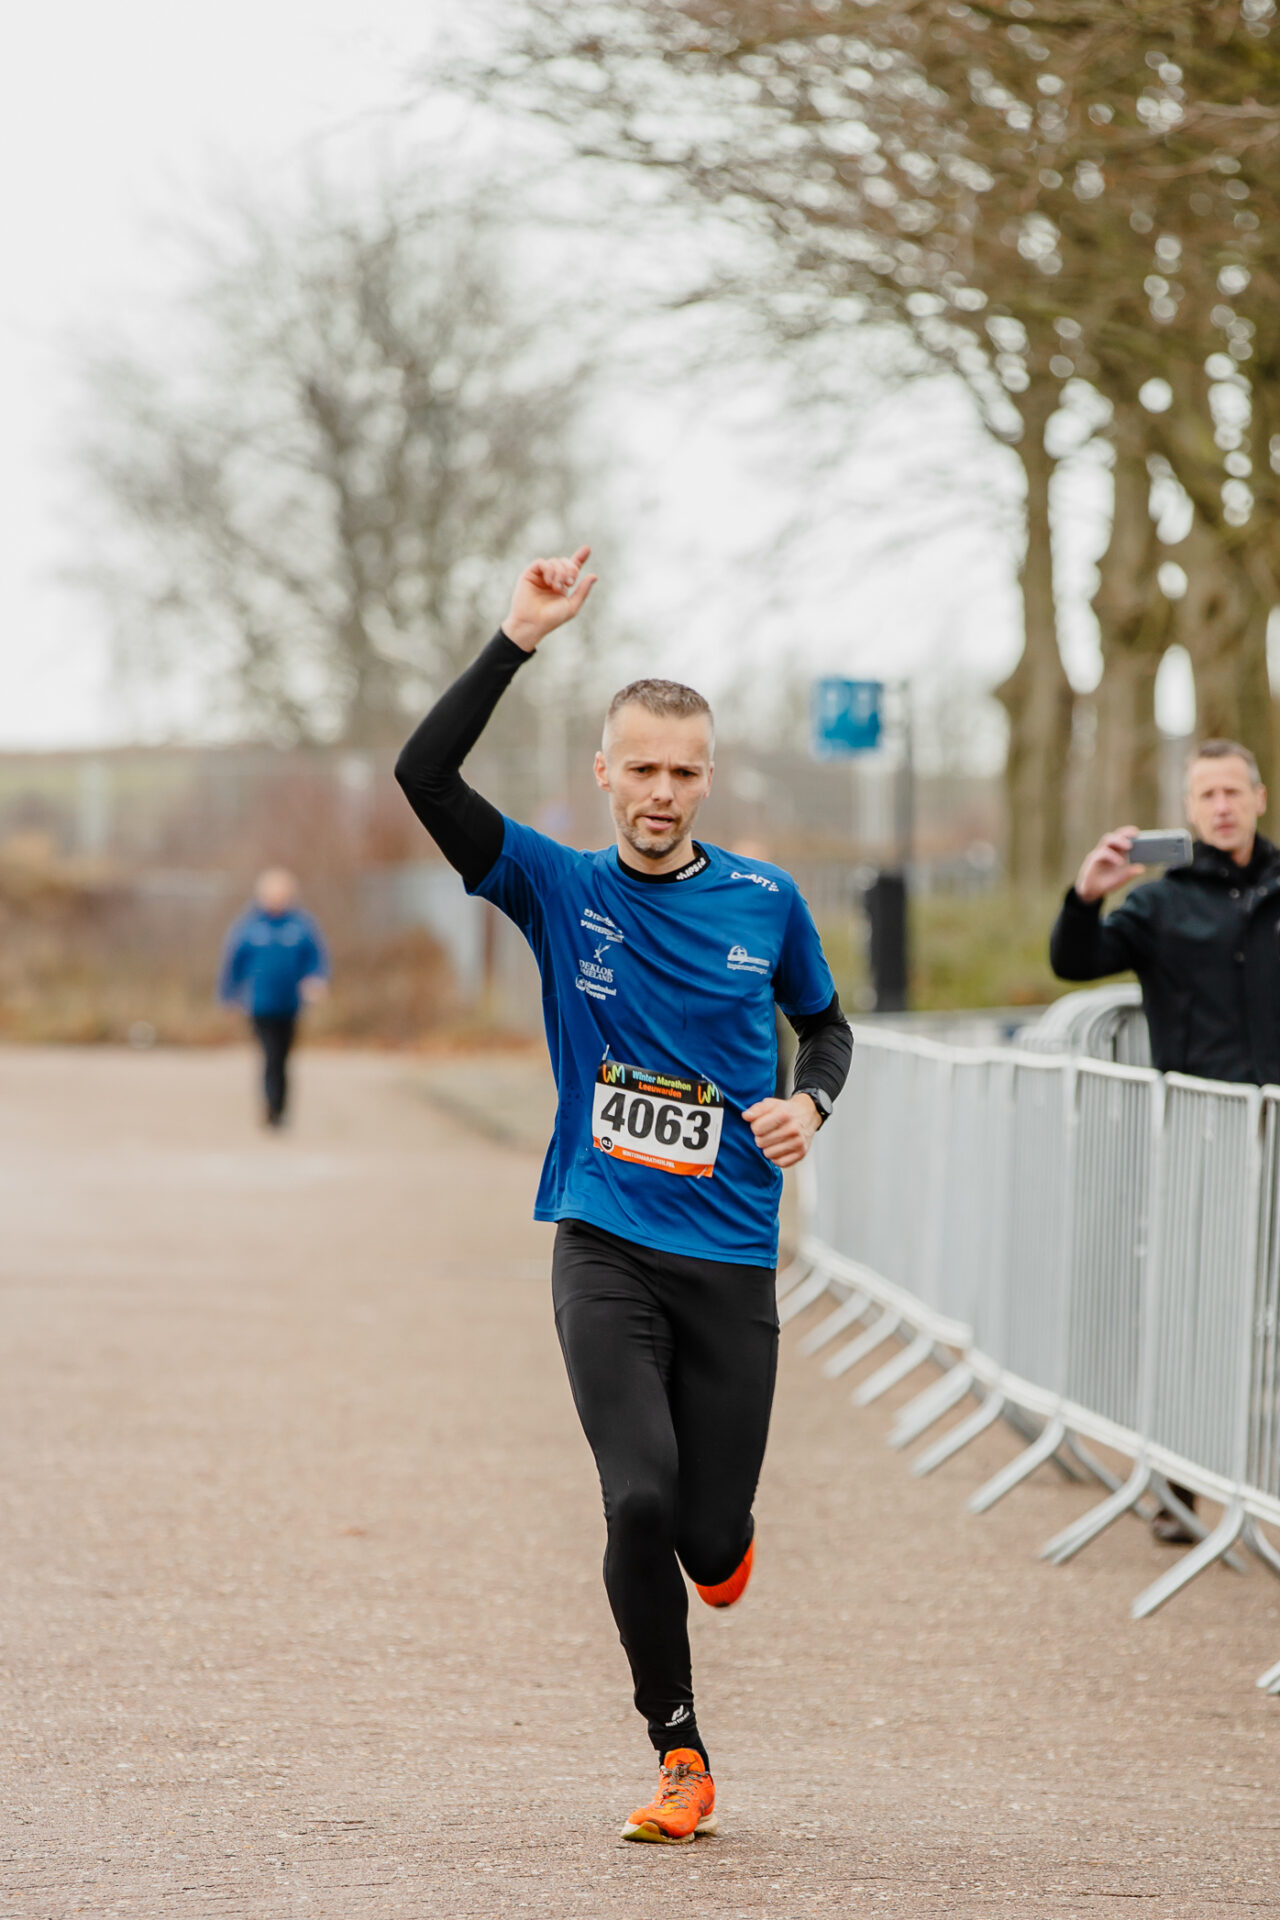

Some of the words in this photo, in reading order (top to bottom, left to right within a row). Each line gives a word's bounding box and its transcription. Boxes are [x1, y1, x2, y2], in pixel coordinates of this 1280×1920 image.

[632, 1070, 656, 1083] Winter
[656, 1076, 692, 1092] Marathon
[638, 1081, 682, 1098] Leeuwarden
[600, 1091, 711, 1151] 4063
